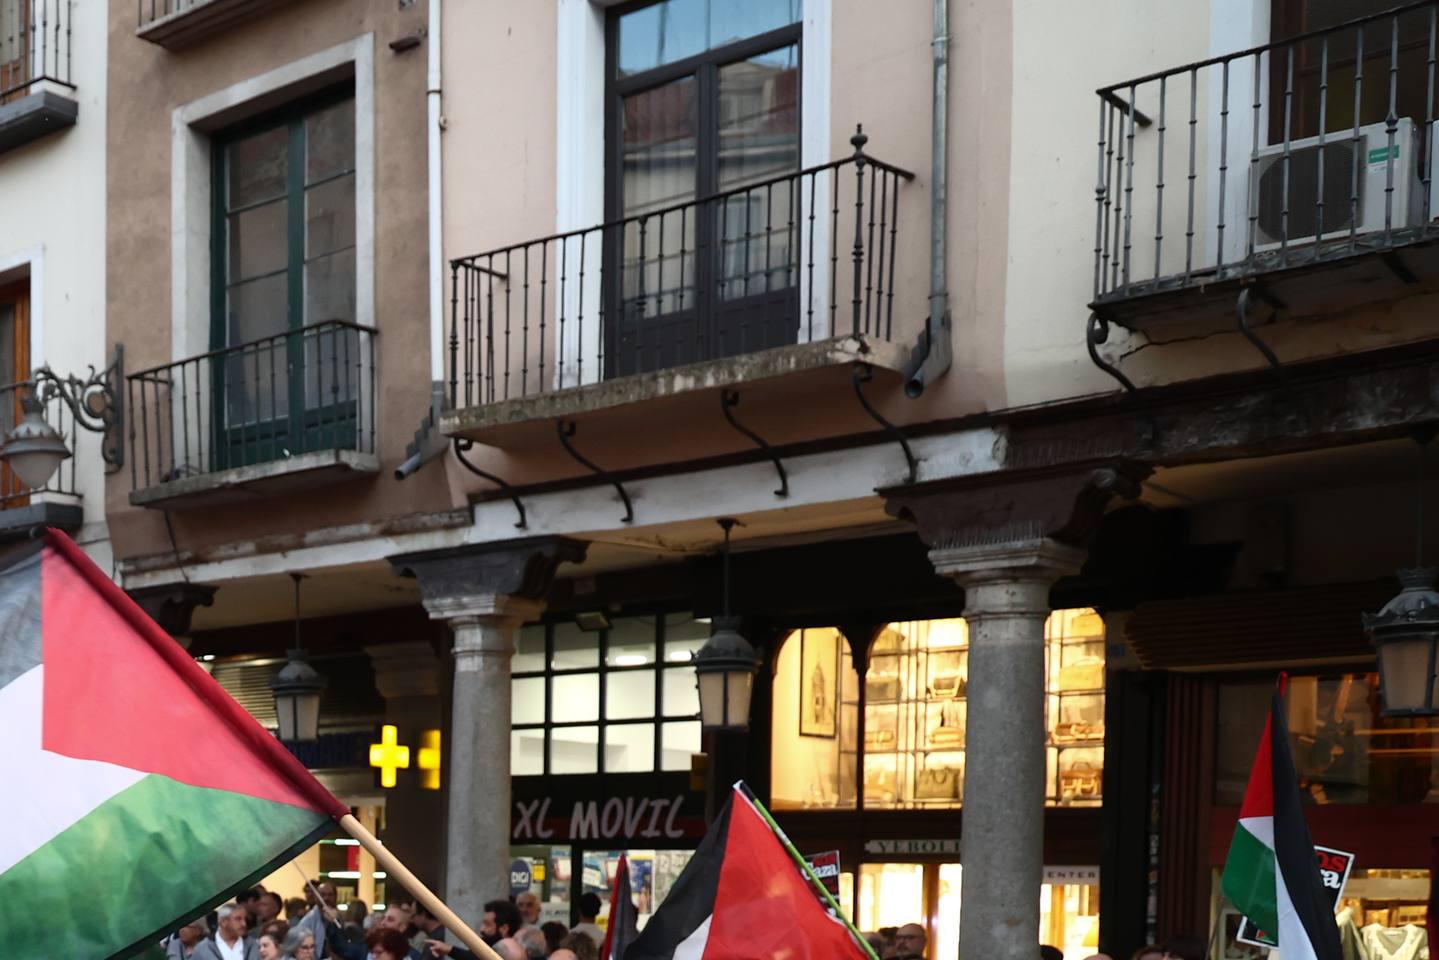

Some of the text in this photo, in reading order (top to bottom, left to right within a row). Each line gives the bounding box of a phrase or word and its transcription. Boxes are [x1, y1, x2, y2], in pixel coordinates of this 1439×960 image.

[513, 795, 685, 840] XL MOVIL
[511, 871, 529, 883] DIGI
